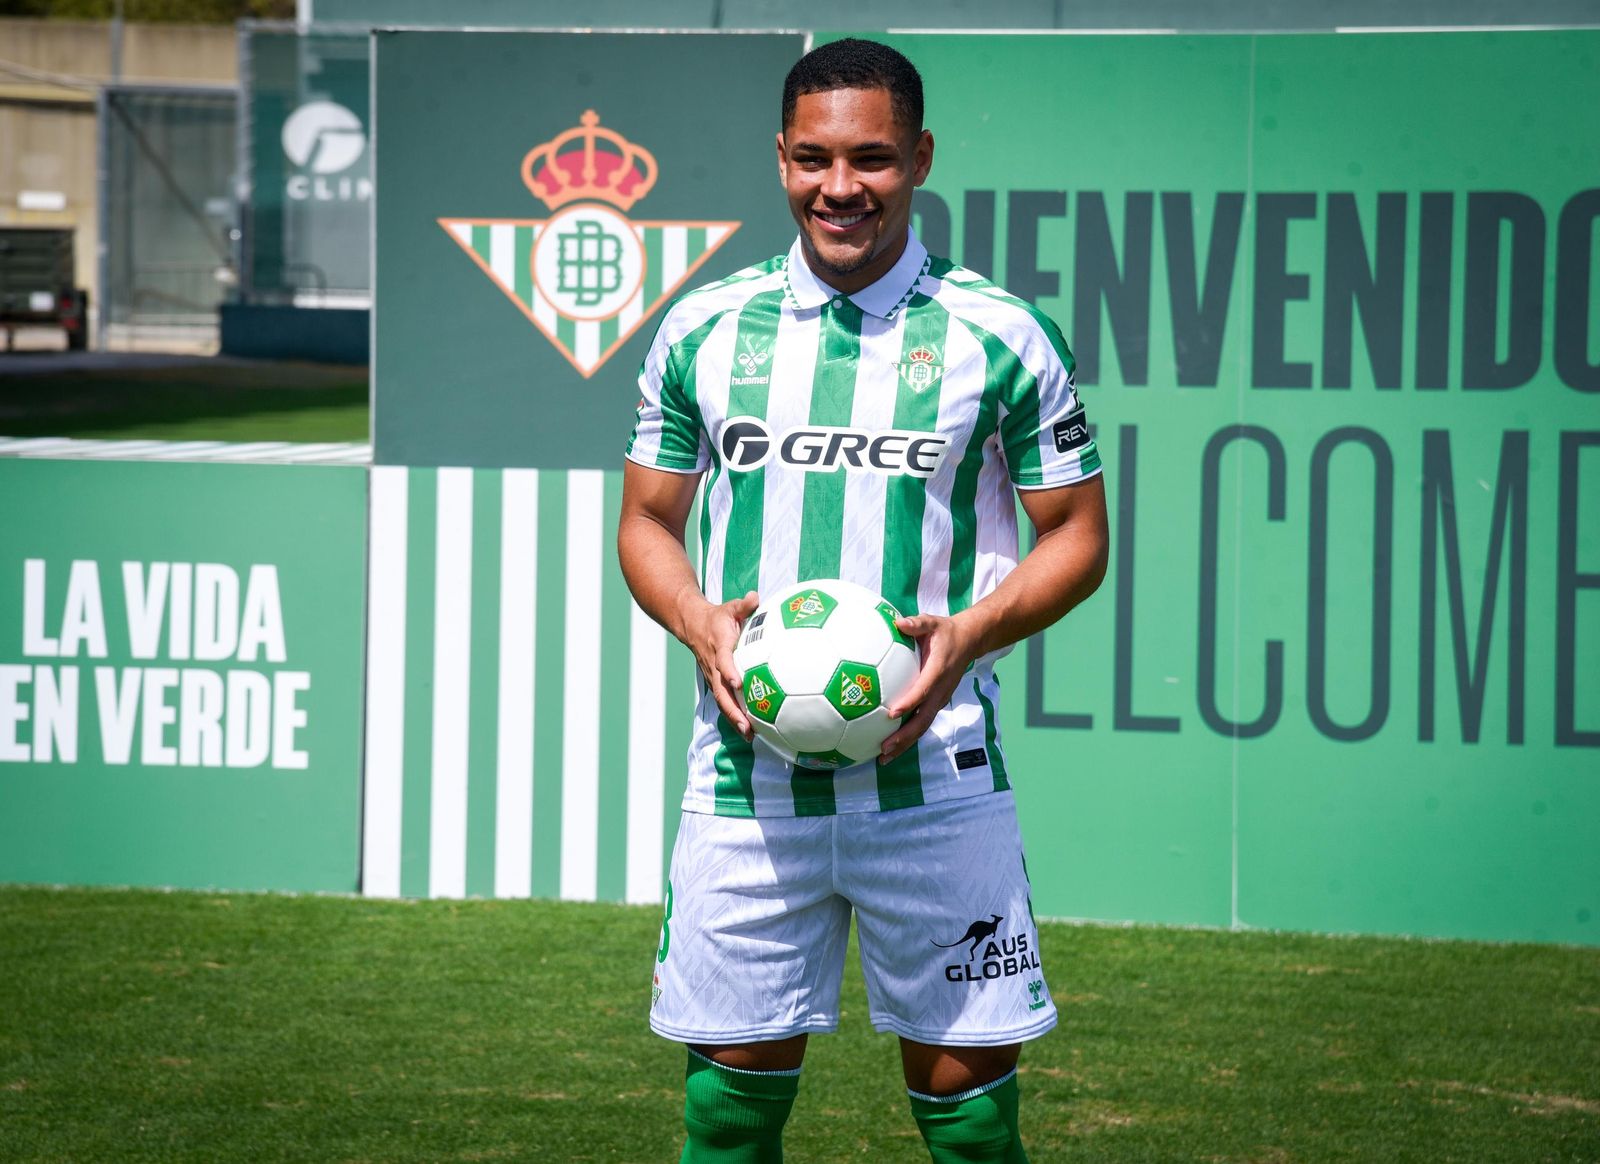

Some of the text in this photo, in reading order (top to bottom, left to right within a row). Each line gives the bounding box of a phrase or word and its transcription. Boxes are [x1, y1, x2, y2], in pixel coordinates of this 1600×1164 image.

[731, 374, 769, 386] hummel
[780, 431, 946, 472] GREE
[22, 558, 288, 663] LA VIDA
[0, 663, 311, 769] EN VERDE
[982, 932, 1029, 961] AUS
[944, 951, 1040, 983] GLOBAL
